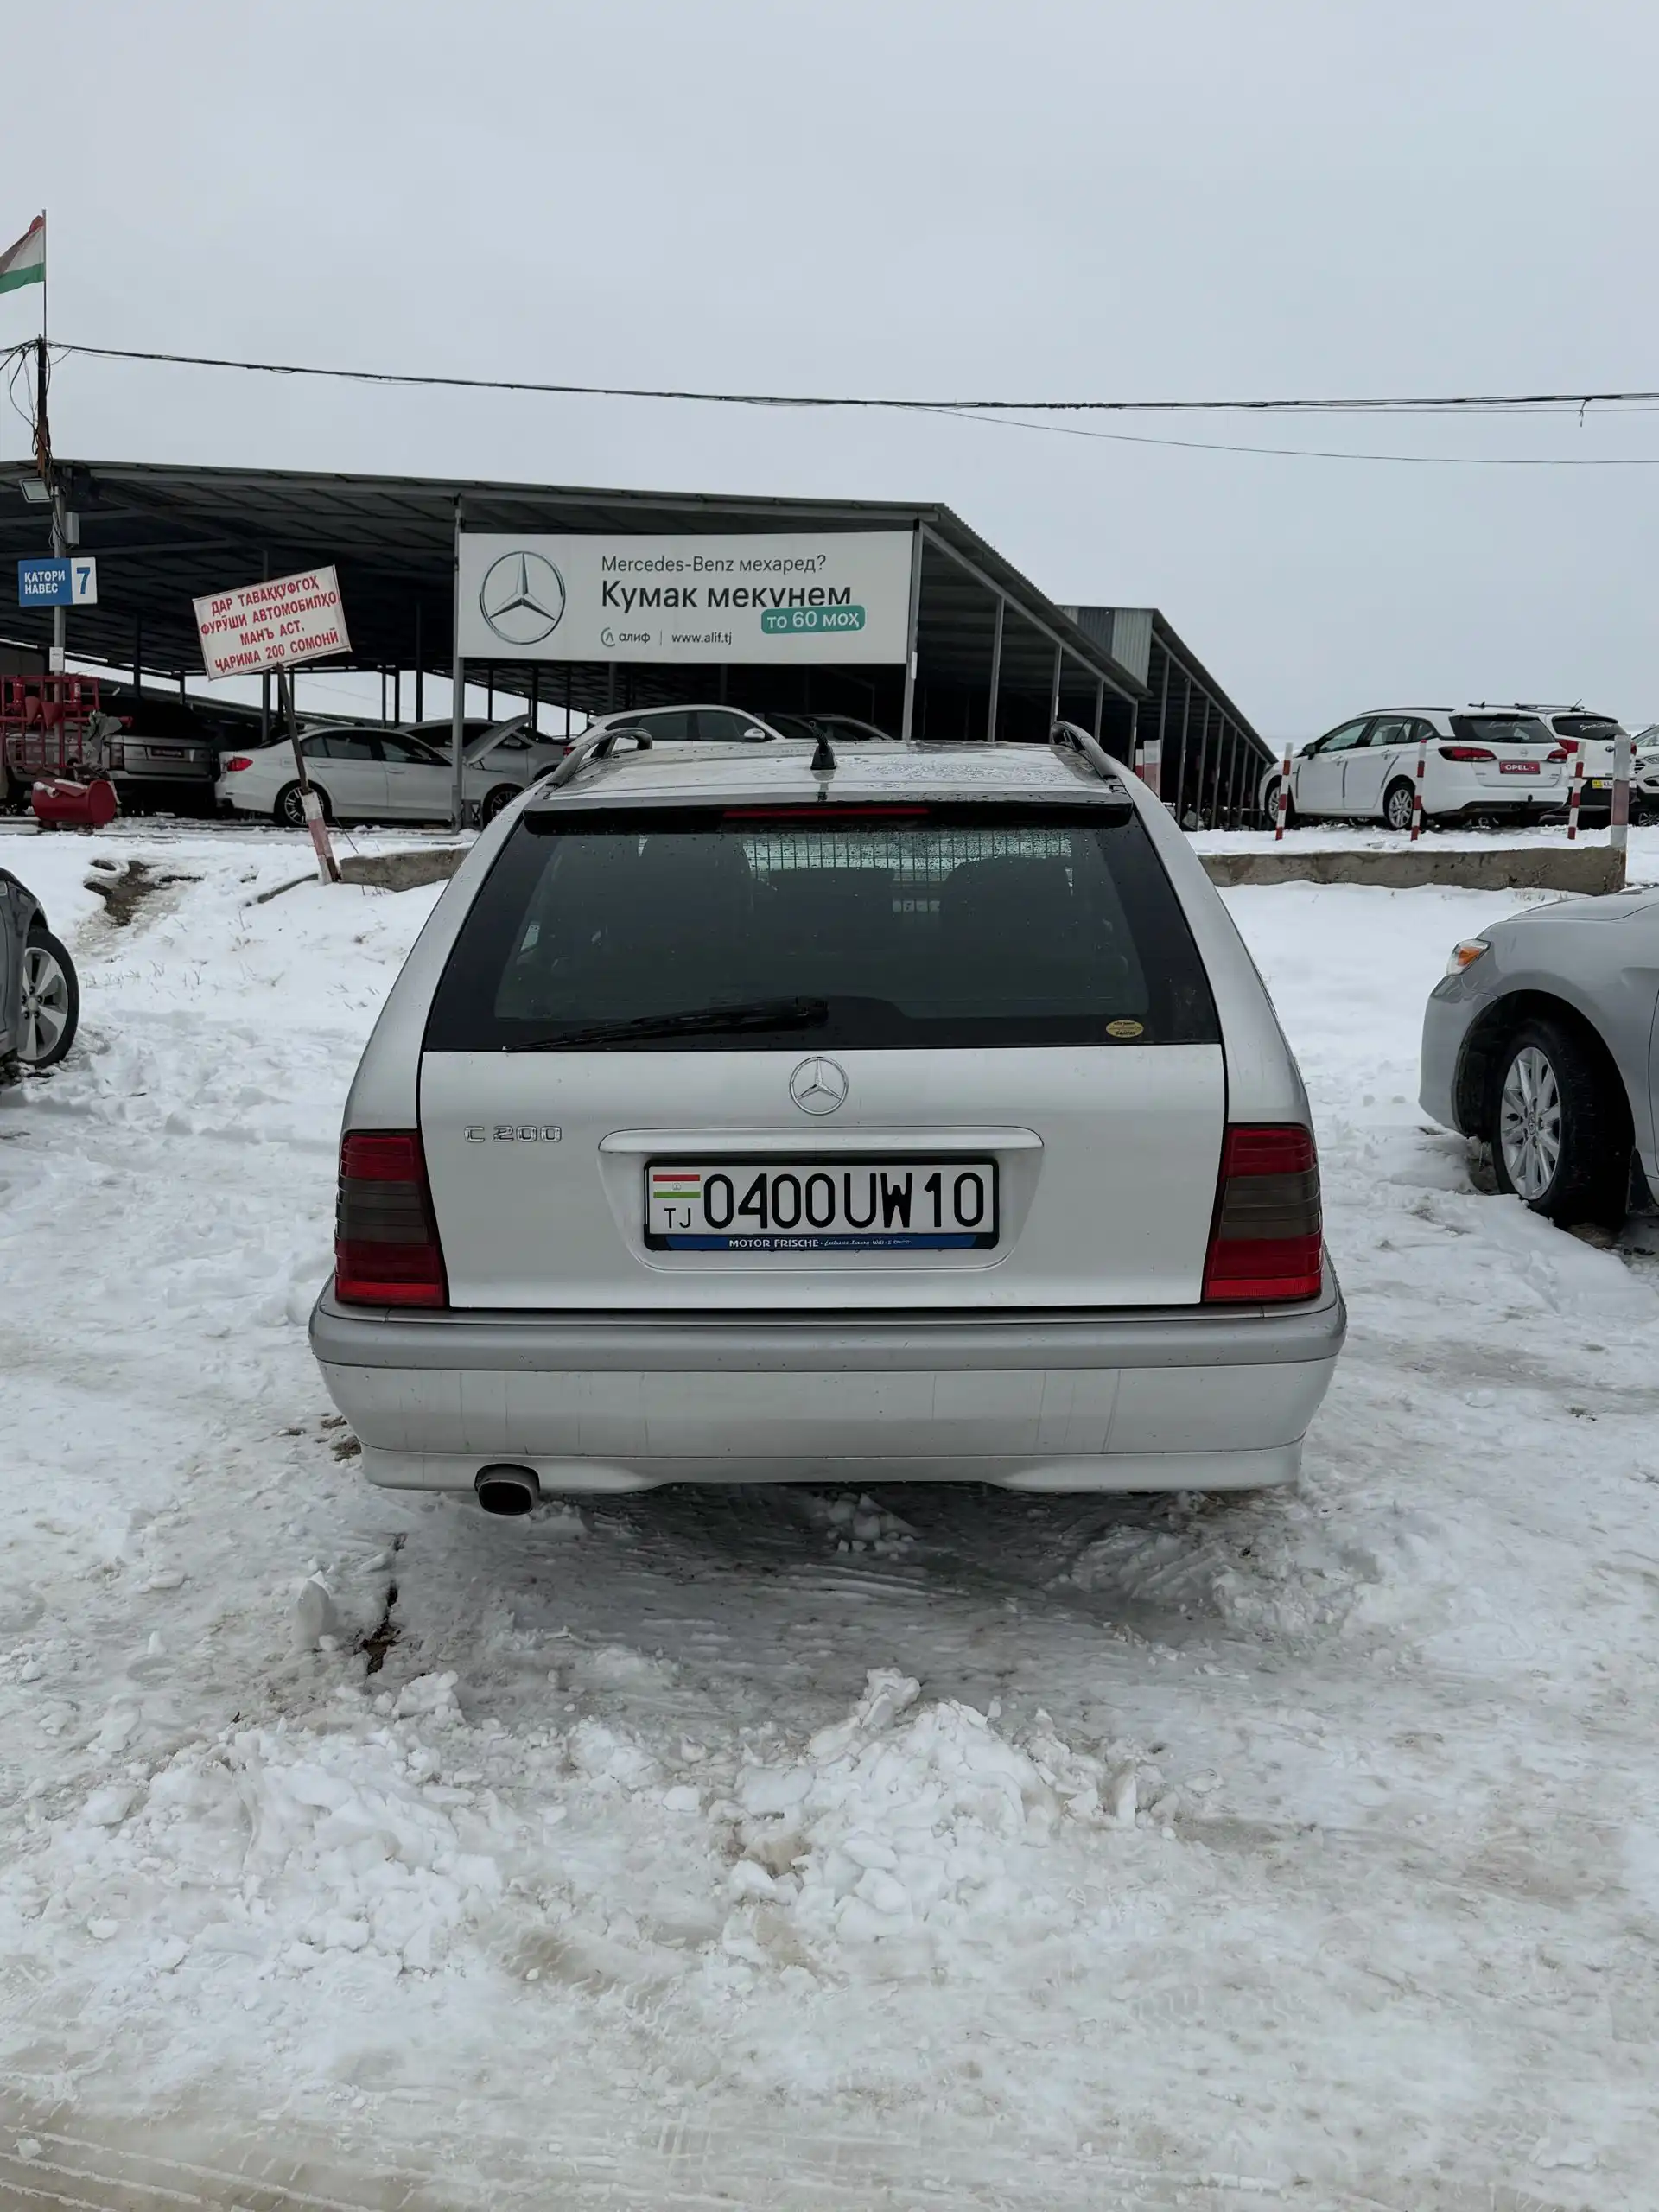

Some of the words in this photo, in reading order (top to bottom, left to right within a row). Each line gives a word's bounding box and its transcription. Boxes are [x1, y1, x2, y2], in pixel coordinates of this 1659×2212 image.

[601, 555, 734, 572] Mercedes-Benz
[740, 554, 826, 575] мехаред?
[24, 570, 66, 584] ҚАТОРИ
[76, 567, 91, 595] 7
[24, 583, 59, 595] НАВЕС
[211, 598, 233, 617] ДАР
[238, 575, 320, 607] ТАВАҚҚУФГОҲ
[601, 580, 698, 614] Кумак
[707, 586, 851, 608] мекунем
[252, 591, 337, 624] АВТОМОБИЛҲО
[766, 615, 788, 629] то
[792, 611, 817, 628] 60
[823, 612, 860, 628] моҳ
[239, 626, 275, 646] МАНЪ
[619, 632, 651, 644] алиф
[671, 631, 733, 646] www.alif.tj
[265, 644, 286, 660] 200
[464, 1125, 486, 1143] C
[493, 1125, 563, 1143] 200
[703, 1172, 984, 1230] 0400UW10
[664, 1206, 692, 1229] TJ
[729, 1239, 771, 1248] MOTOR
[774, 1239, 819, 1248] FRISCHE
